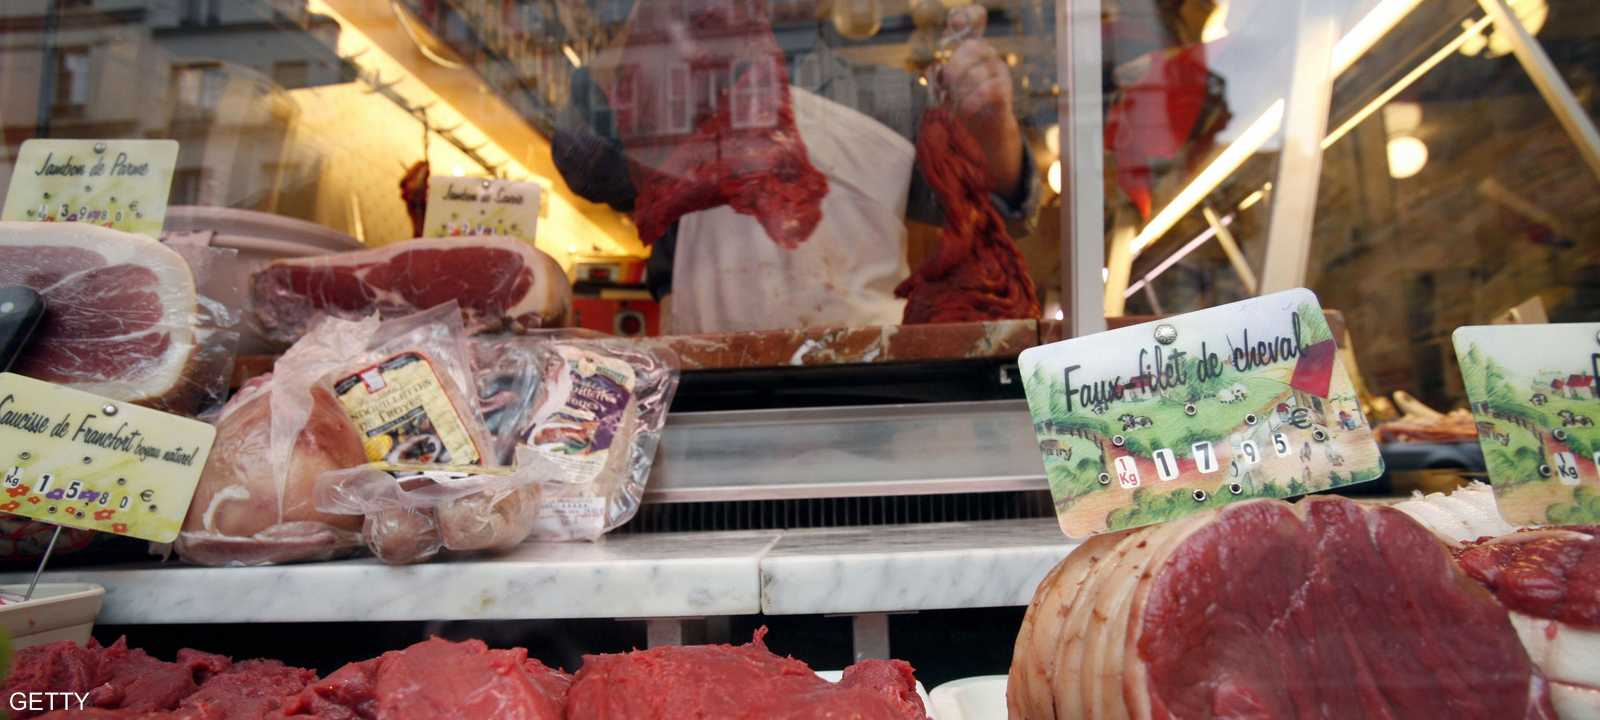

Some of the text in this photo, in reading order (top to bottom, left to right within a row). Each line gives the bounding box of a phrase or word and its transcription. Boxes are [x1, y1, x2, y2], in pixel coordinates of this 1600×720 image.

[35, 152, 149, 177] Jambon de Parme
[1196, 342, 1223, 383] de
[1231, 311, 1305, 373] cheval
[50, 413, 71, 439] de
[72, 414, 141, 453] Francfort
[162, 445, 200, 467] naturel
[5, 474, 20, 487] Kg
[1118, 469, 1138, 486] Kg
[1559, 465, 1579, 480] Kg
